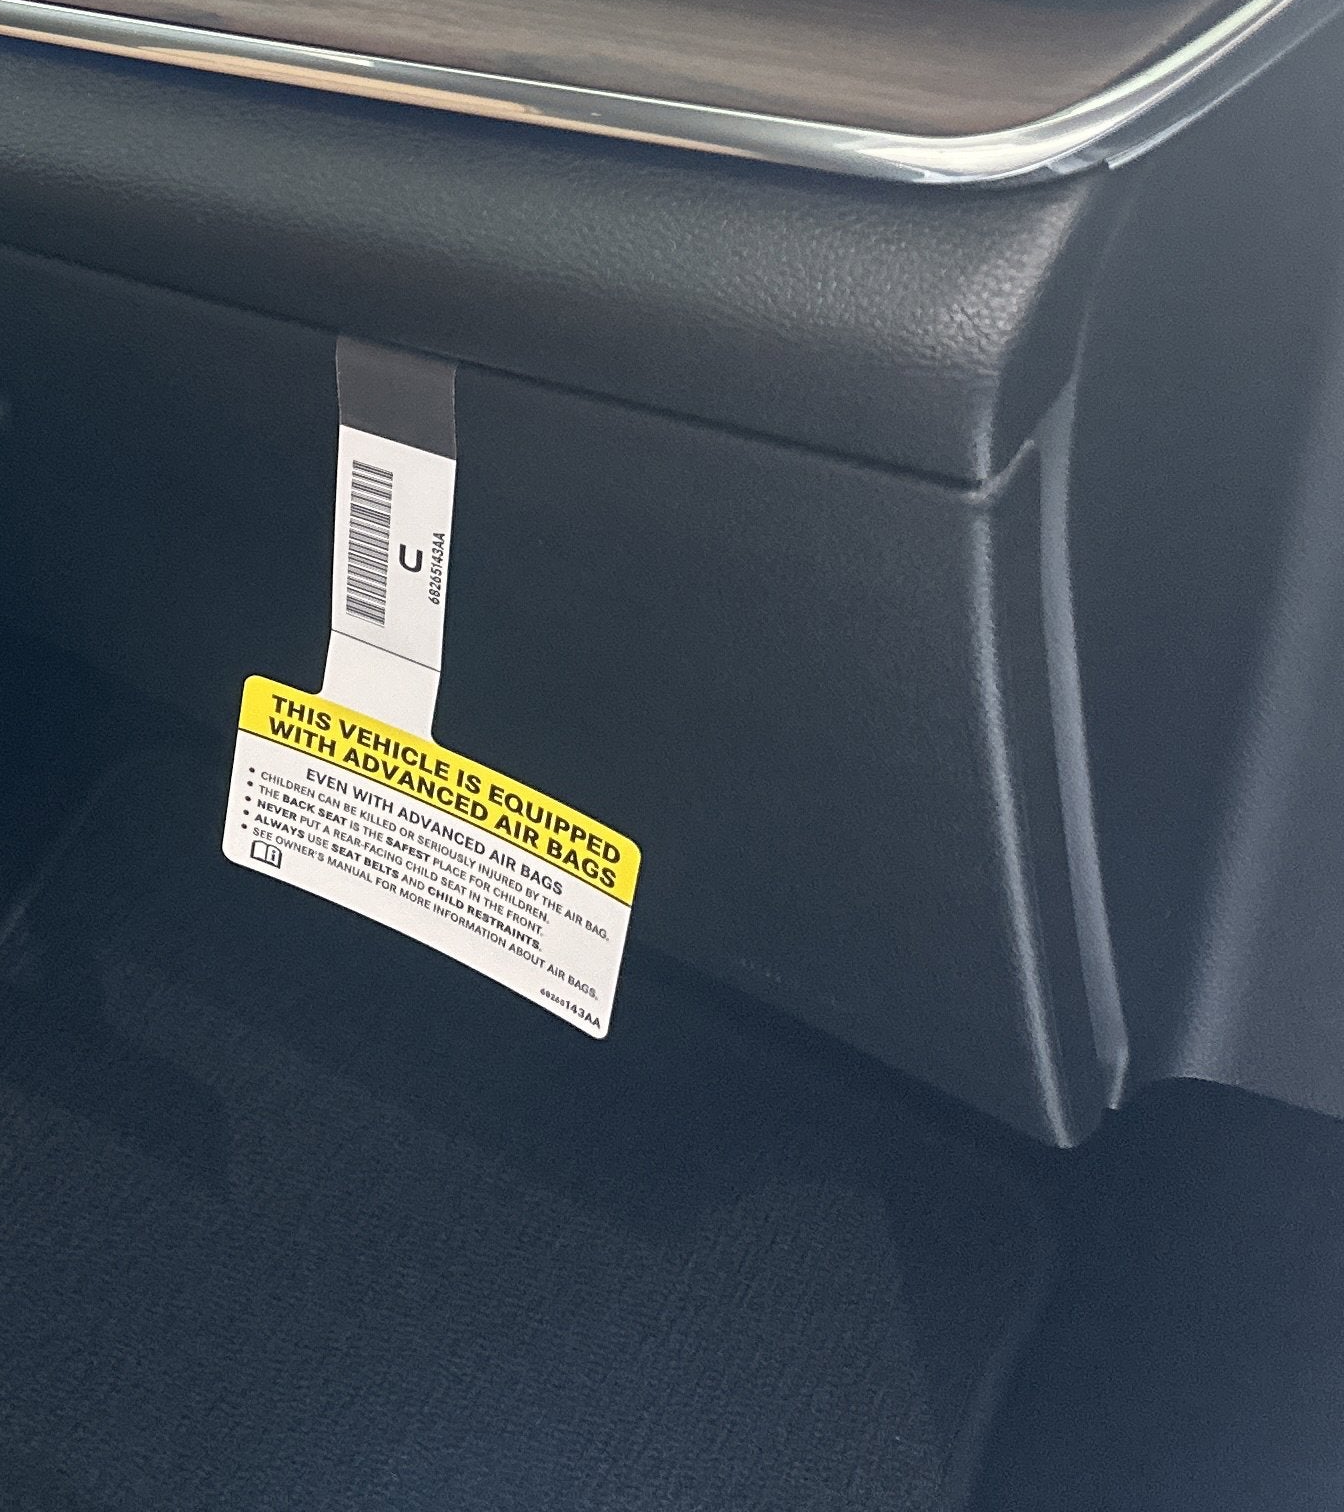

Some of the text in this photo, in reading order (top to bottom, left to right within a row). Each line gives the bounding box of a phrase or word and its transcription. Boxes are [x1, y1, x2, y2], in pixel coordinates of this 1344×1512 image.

[428, 532, 445, 605] 68265143AA
[269, 716, 616, 888] WITH ADVANCED AIR BAGS
[272, 694, 620, 863] THIS VEHICLE IS EQUIPPED
[307, 768, 562, 895] EVEN WITH ADVANCED AIR BAGS
[253, 827, 598, 1000] SEE OWNER'S MANUAL FOR MORE INFORMATION ABOUT AIR BAGS.
[254, 814, 541, 951] ALWAYS USE SEAT BELTS AND CHILD RESTRAINTS.
[257, 799, 543, 936] NEVER PUT A REAR-FACING CHILD SEAT IN THE FRONT.
[259, 785, 549, 924] THE BACK SEAT IS THE SAFEST PLACE FOR CHILDREN.
[261, 772, 609, 941] CHILDREN CAN BE KILLED OR SERIOUSLY INJURED BY THE AIR BAG.
